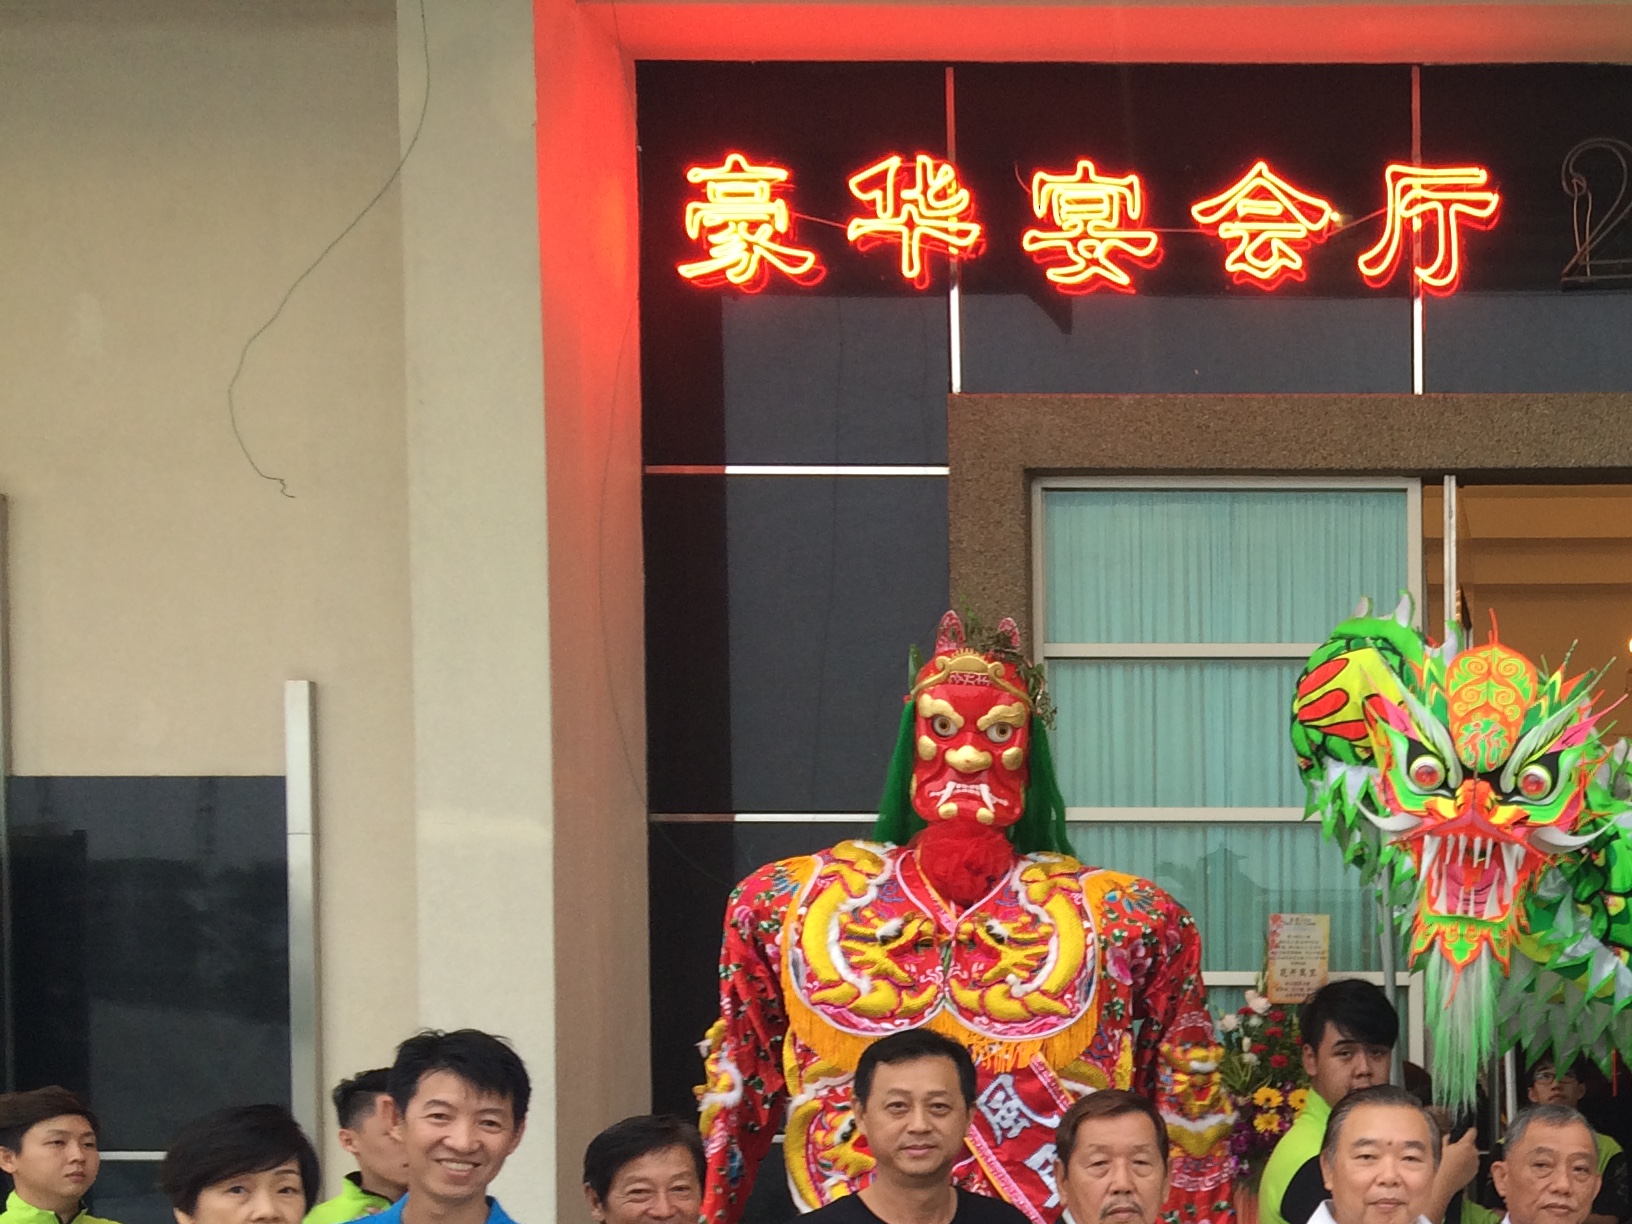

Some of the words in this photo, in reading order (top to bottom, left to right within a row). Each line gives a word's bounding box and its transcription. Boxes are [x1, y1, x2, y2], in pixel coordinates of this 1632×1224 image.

[677, 152, 1503, 290] 豪华宴会厅
